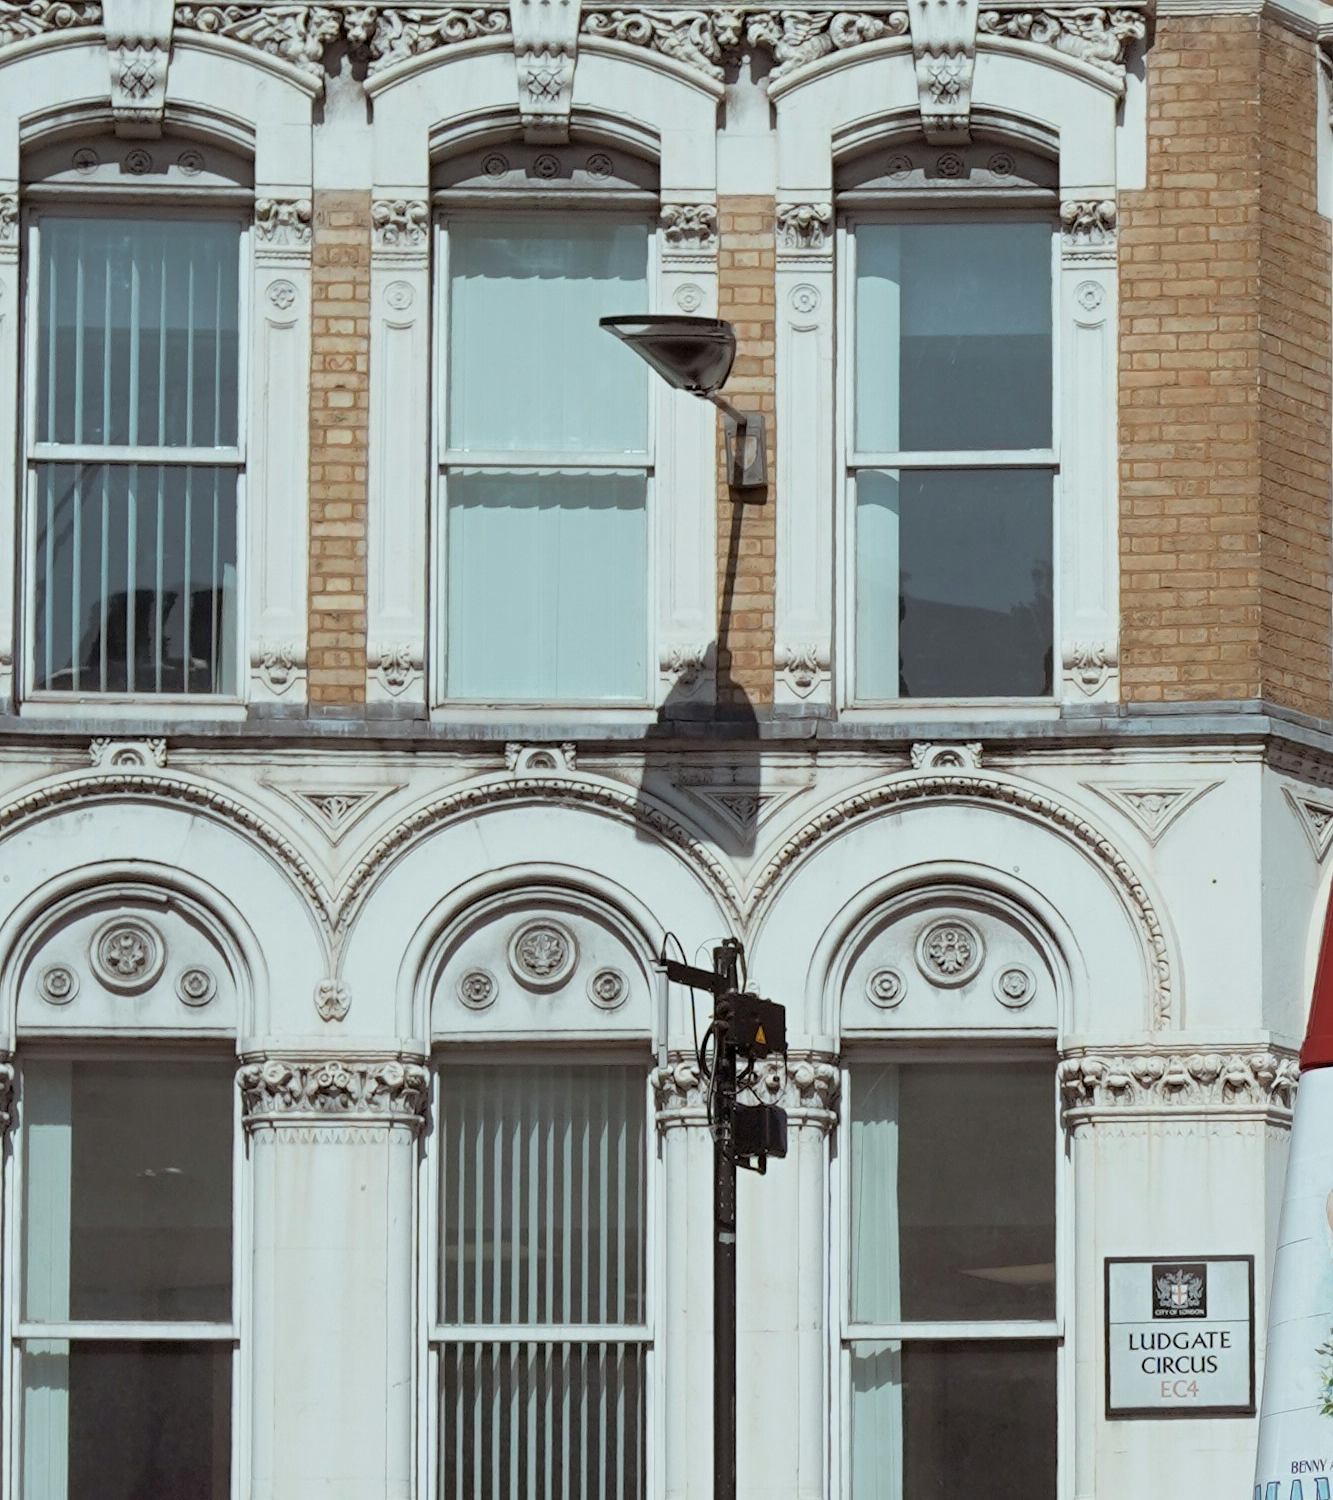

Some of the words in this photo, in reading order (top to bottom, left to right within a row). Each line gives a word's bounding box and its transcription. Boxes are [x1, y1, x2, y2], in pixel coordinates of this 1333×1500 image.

[1154, 1308, 1169, 1316] CITY
[1169, 1308, 1178, 1316] OF
[1178, 1308, 1206, 1316] LONDON
[1128, 1331, 1232, 1351] LUDGATE
[1141, 1355, 1218, 1374] CIRCUS
[1160, 1380, 1200, 1398] EC4
[1291, 1457, 1327, 1475] BENNY
